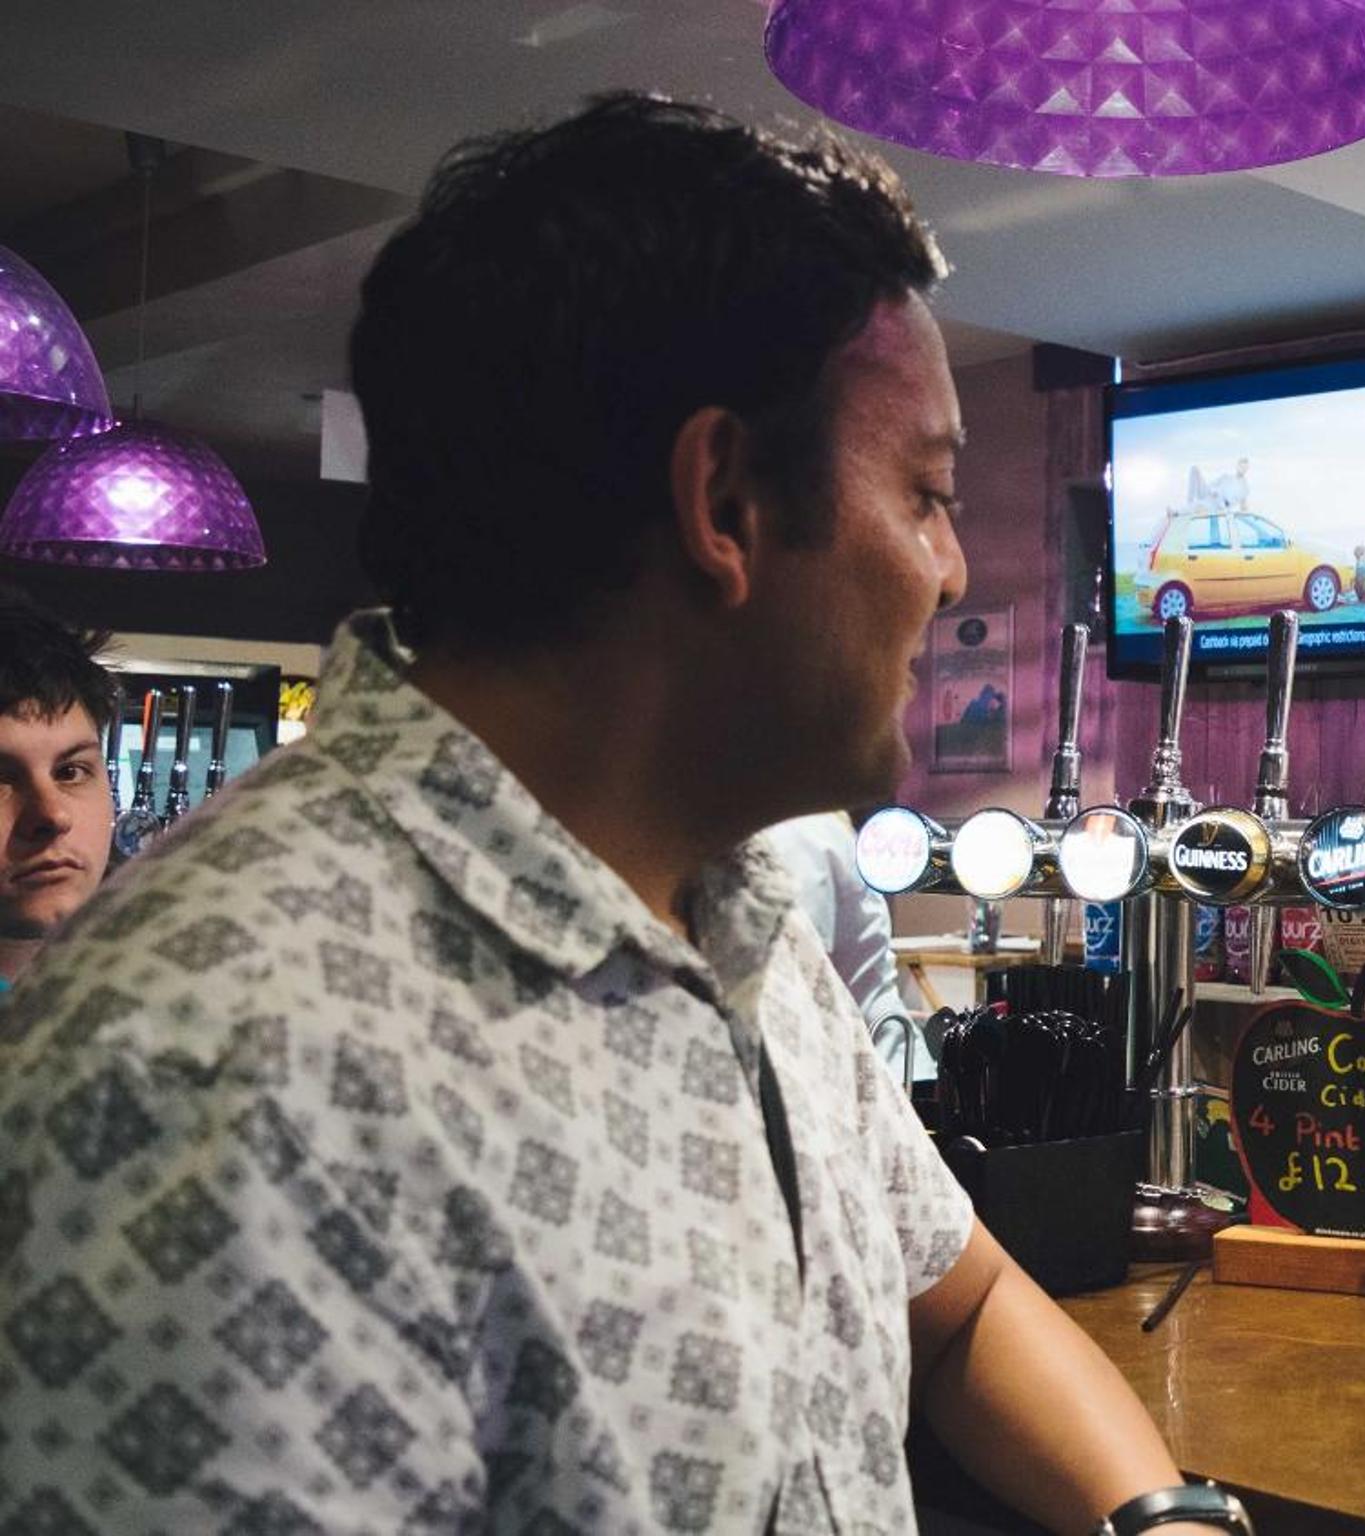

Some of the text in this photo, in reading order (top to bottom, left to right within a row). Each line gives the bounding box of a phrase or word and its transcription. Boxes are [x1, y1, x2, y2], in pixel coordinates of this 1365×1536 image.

[1174, 844, 1248, 871] GUINNESS
[1252, 1037, 1322, 1066] CARLING
[1262, 1077, 1307, 1092] CIDER
[1249, 1103, 1275, 1136] 4
[1296, 1111, 1361, 1151] Pint
